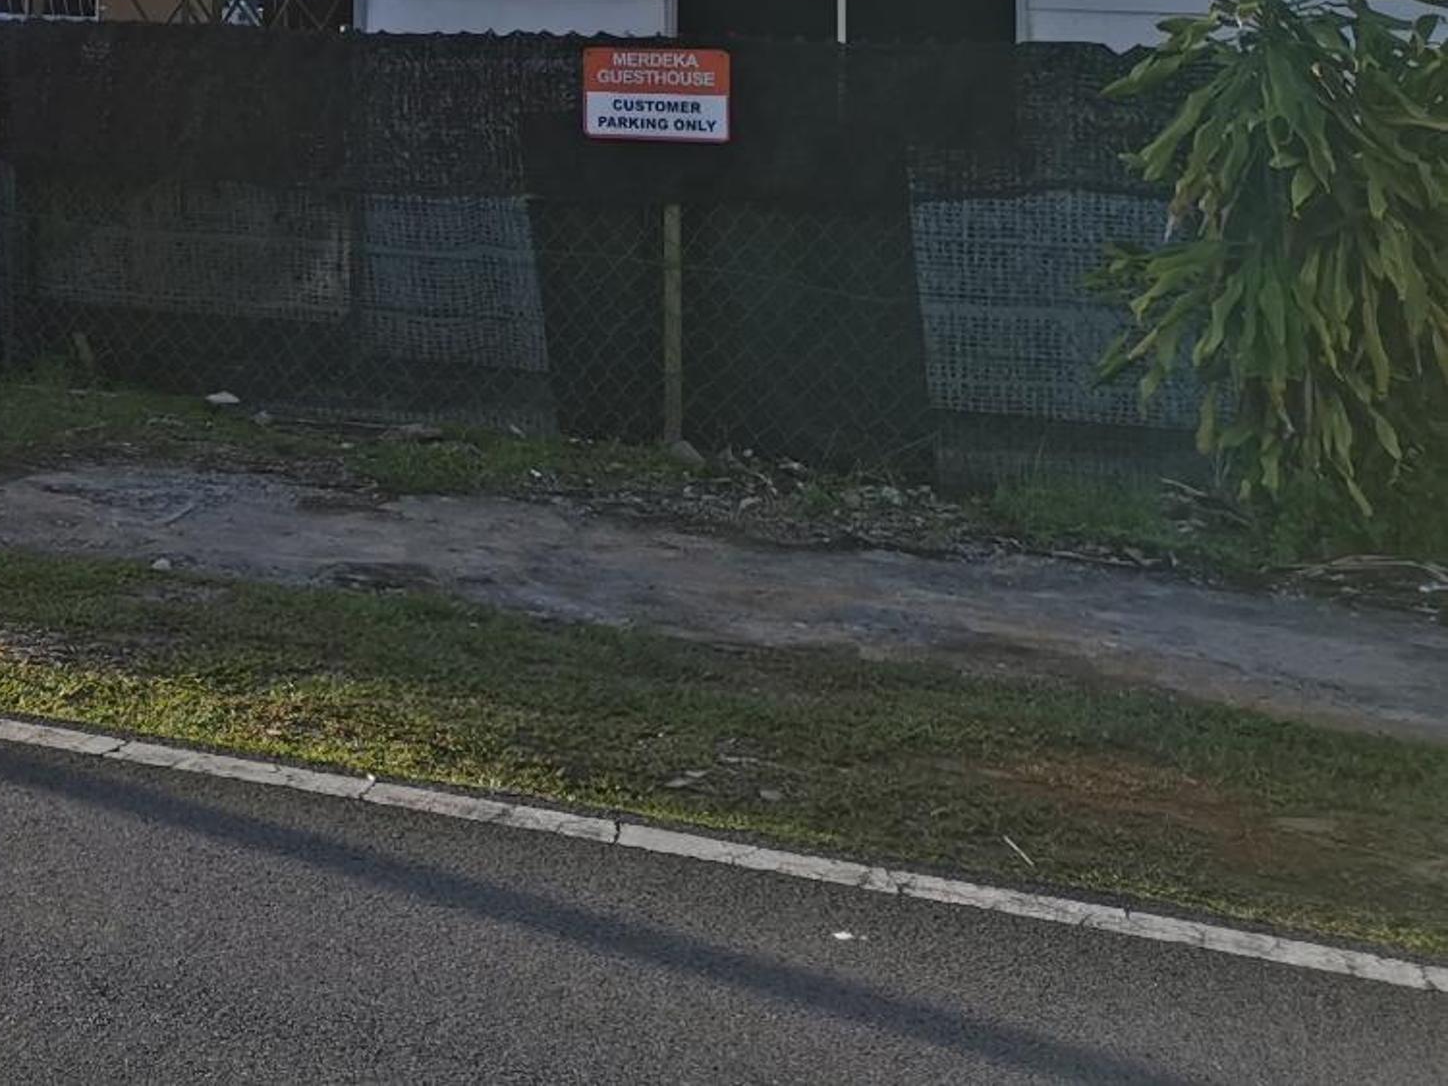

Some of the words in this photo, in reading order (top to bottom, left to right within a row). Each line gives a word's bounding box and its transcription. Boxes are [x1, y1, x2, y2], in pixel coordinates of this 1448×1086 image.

[613, 52, 699, 67] MERDEKA
[597, 70, 715, 86] GUESTHOUSE
[612, 99, 701, 114] CUSTOMER
[598, 116, 668, 131] PARKING
[673, 119, 717, 132] ONLY
